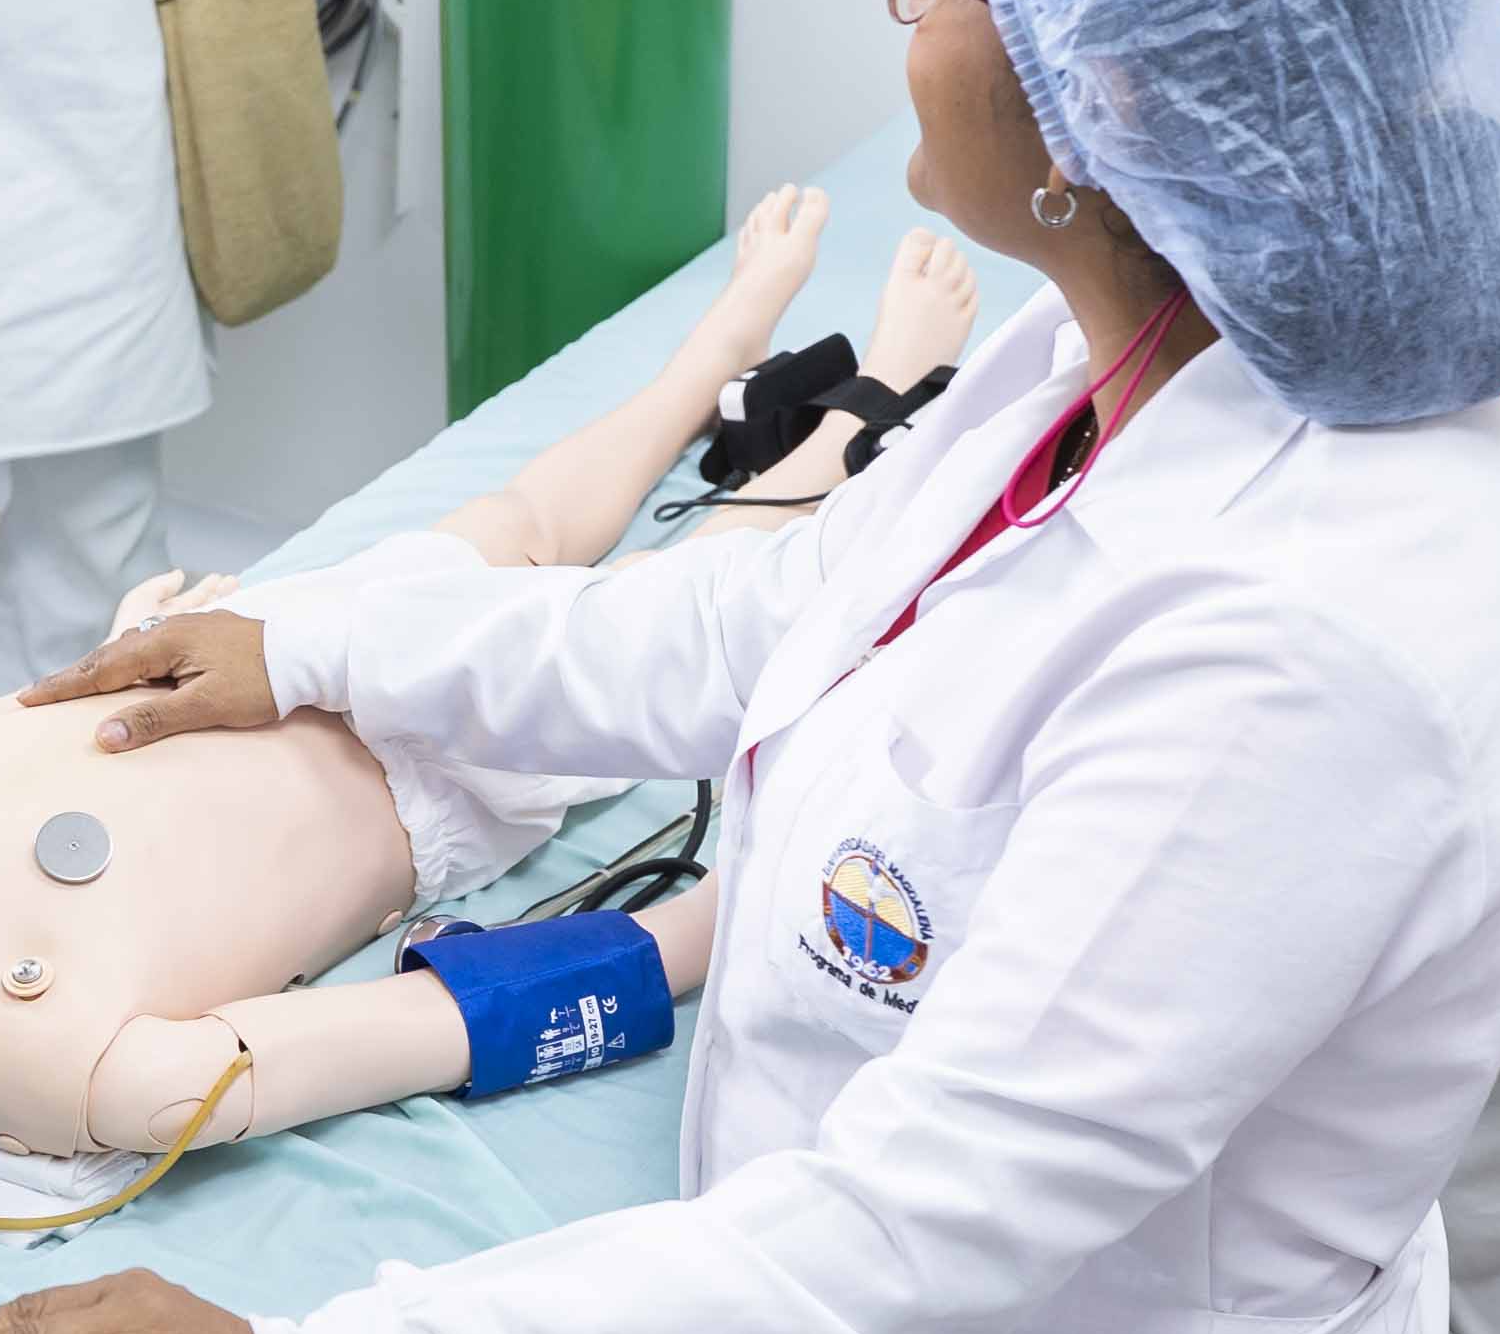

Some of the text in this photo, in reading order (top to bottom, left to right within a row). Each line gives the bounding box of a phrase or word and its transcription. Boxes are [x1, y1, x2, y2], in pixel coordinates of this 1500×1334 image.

[888, 863, 935, 941] MAGDALENA
[798, 934, 852, 988] Programa
[859, 982, 876, 998] de
[844, 946, 894, 980] 1962
[585, 998, 595, 1014] cm
[588, 1018, 599, 1044] 19-27
